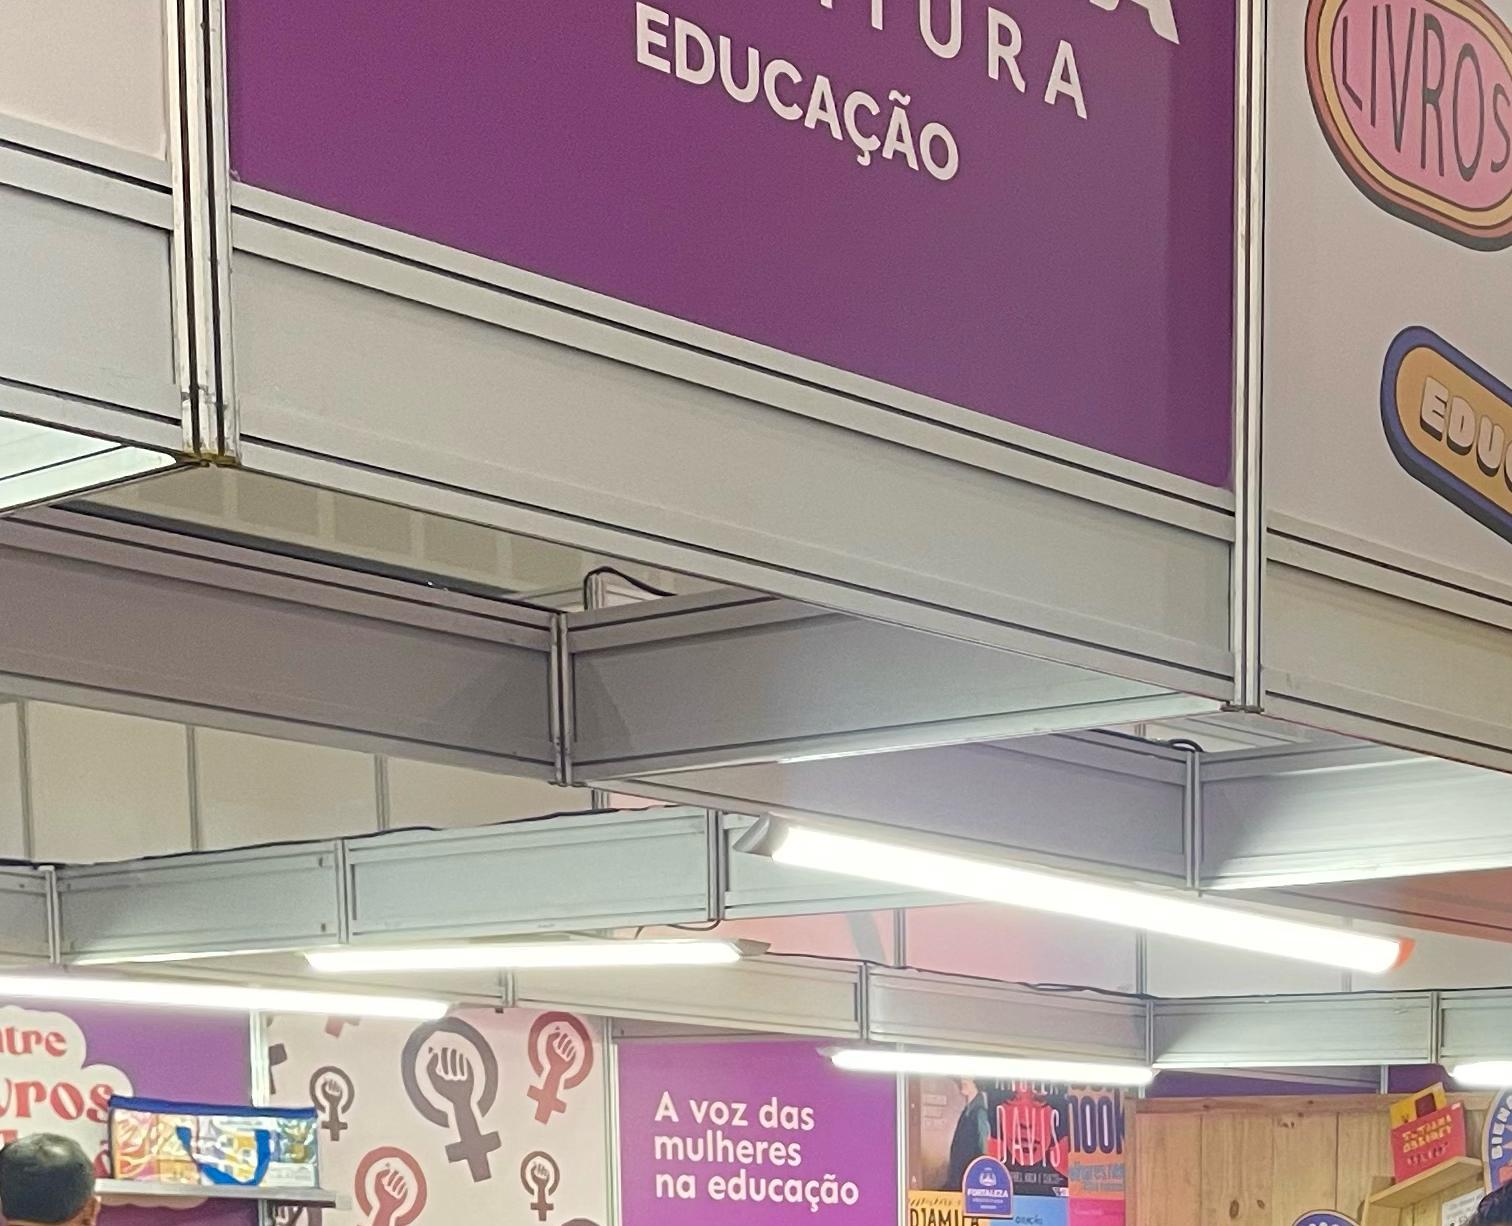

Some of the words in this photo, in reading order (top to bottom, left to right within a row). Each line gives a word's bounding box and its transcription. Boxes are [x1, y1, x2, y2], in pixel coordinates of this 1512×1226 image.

[635, 1, 959, 181] EDUCAÇÃO
[1342, 4, 1511, 182] LIVROS
[0, 1026, 67, 1057] tre
[654, 1091, 679, 1122] A
[689, 1099, 748, 1126] voz
[759, 1096, 815, 1131] das
[654, 1129, 802, 1167] mulheres
[996, 1105, 1061, 1168] DAVIS
[655, 1173, 696, 1199] na
[708, 1168, 859, 1213] educação
